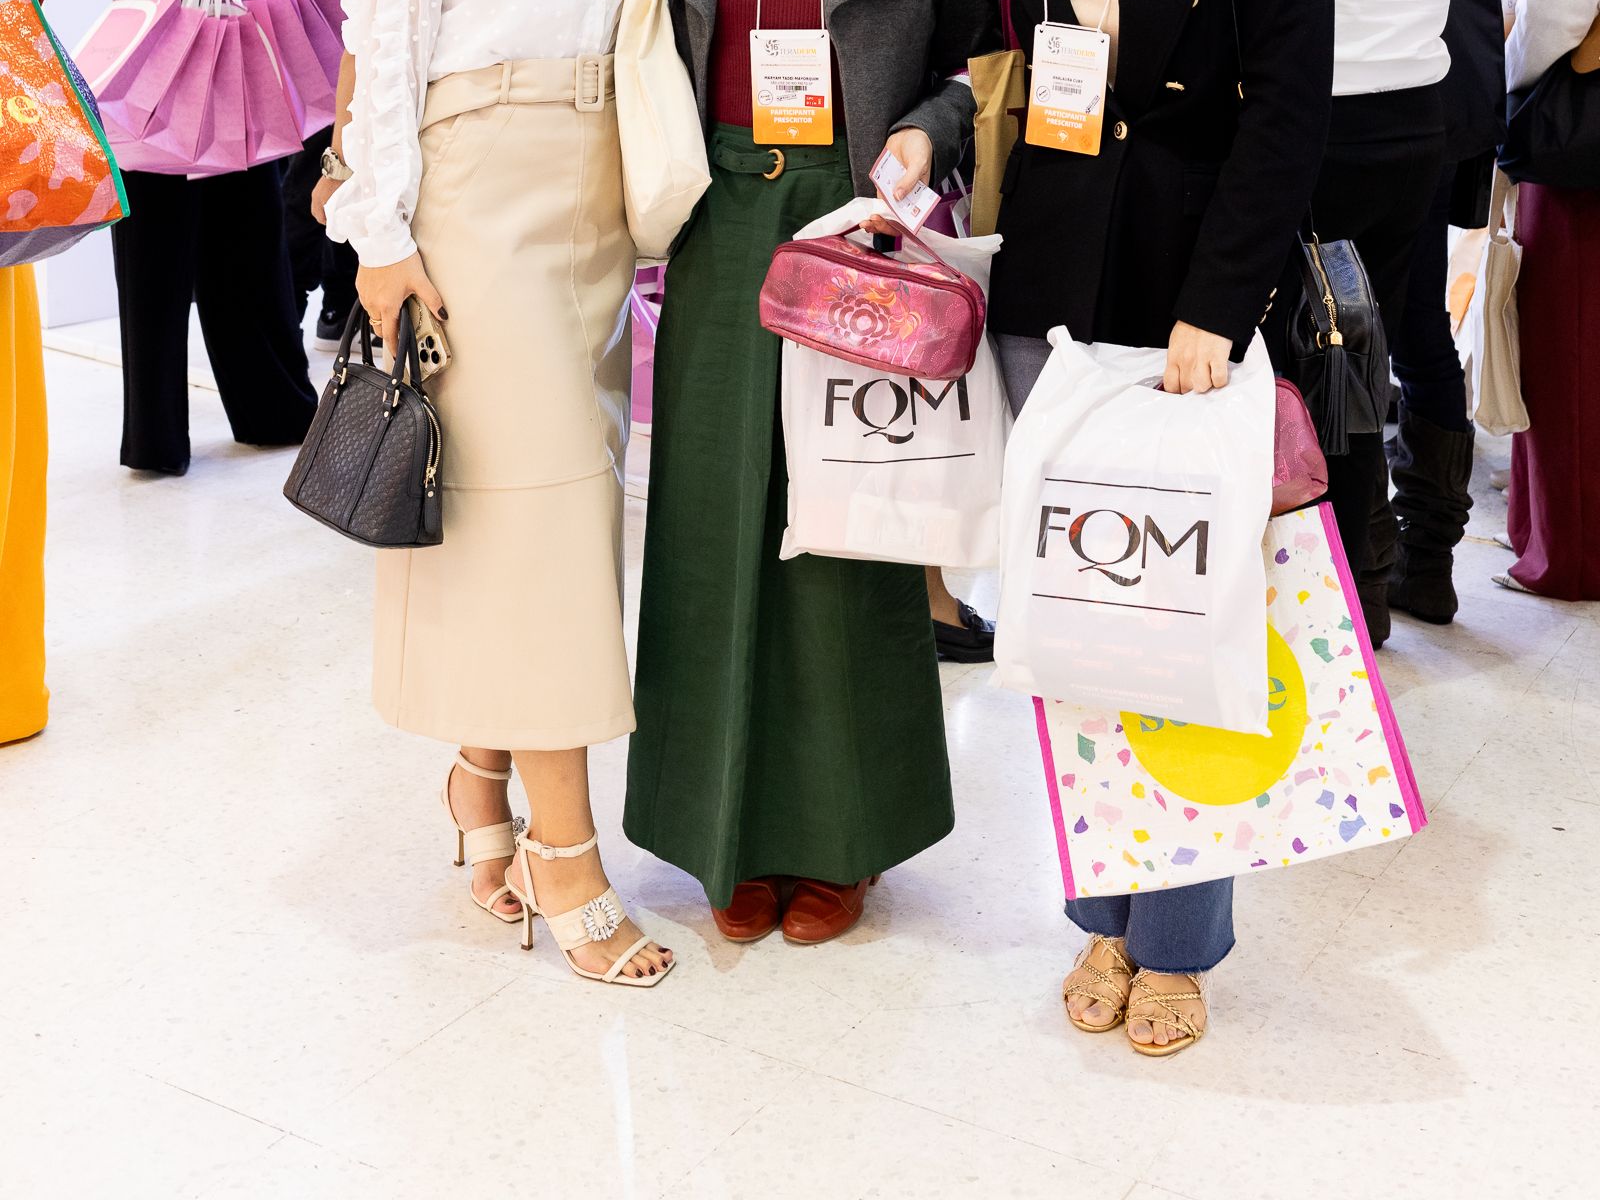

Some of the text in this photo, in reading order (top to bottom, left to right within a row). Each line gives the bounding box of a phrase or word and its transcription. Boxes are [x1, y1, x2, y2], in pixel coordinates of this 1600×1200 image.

[770, 109, 816, 117] PARTICIPANTE
[1044, 108, 1087, 122] PARTICIPANTE
[823, 376, 971, 445] FQM
[1036, 504, 1210, 588] FQM
